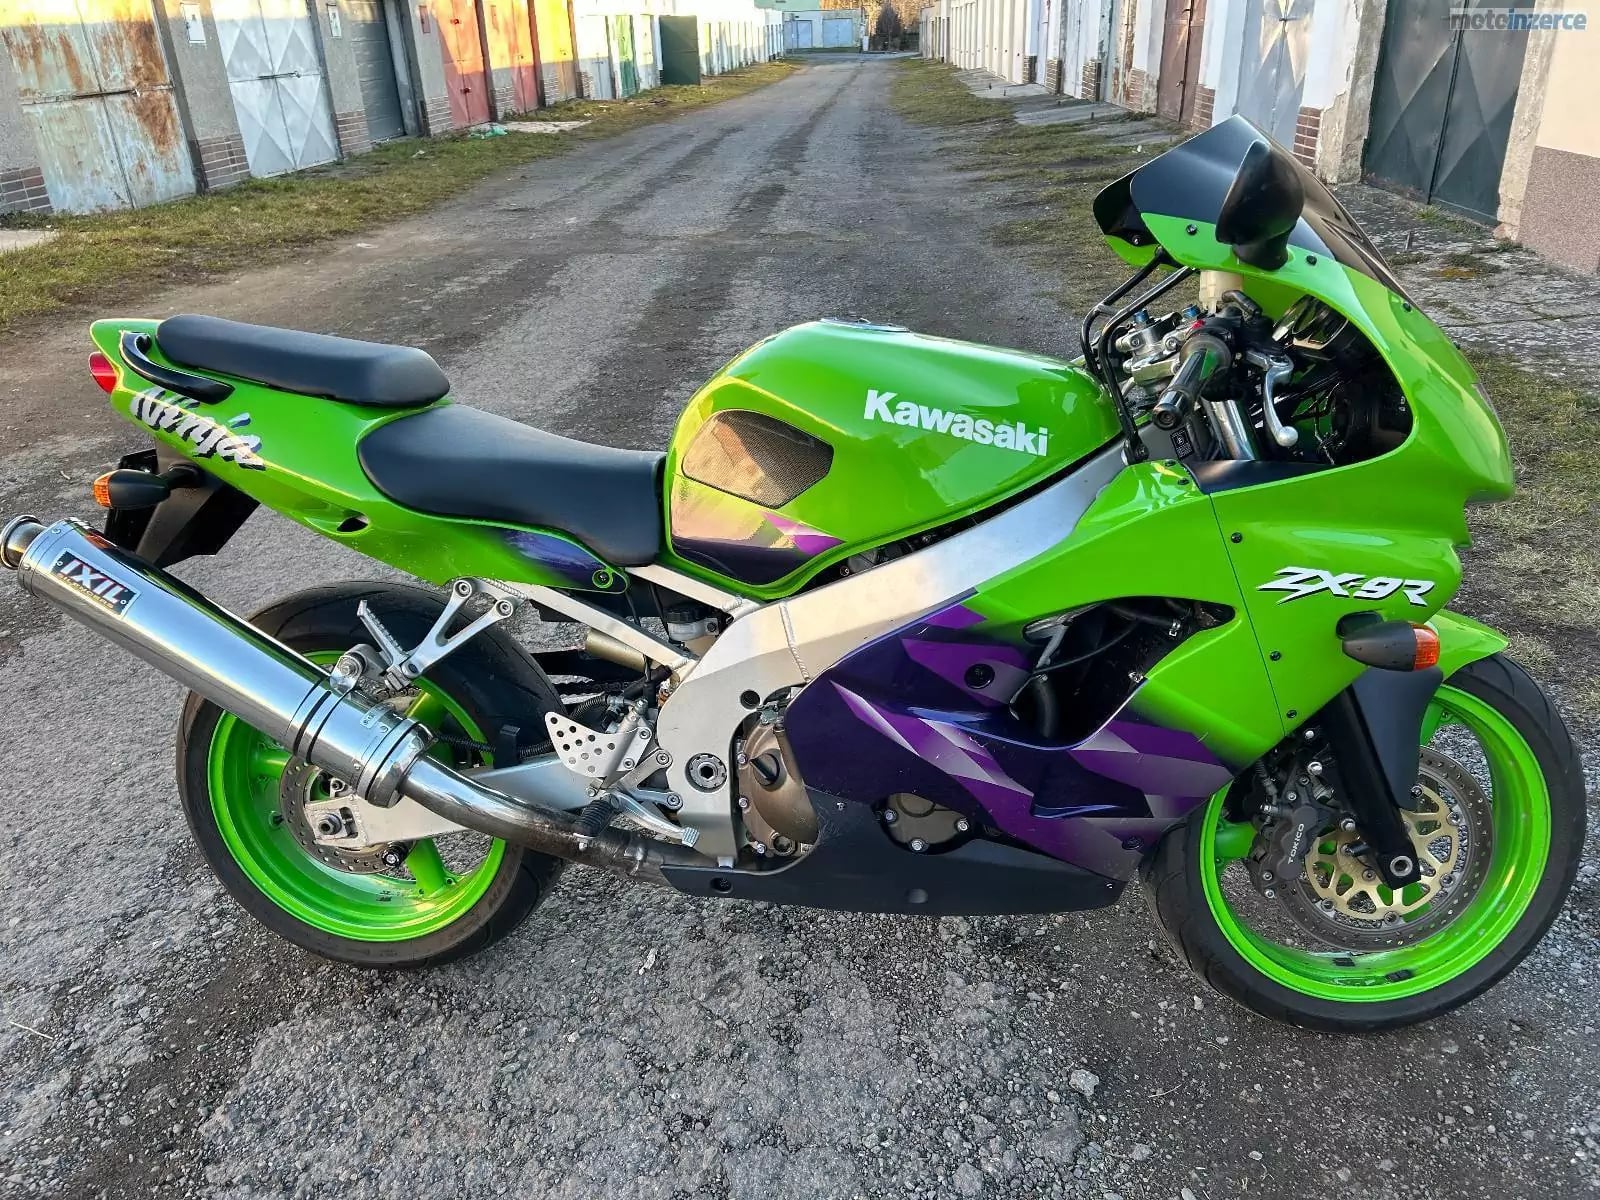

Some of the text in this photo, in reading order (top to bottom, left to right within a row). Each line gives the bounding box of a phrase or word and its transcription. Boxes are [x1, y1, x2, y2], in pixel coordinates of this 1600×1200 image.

[129, 385, 266, 471] Ninja
[863, 389, 1048, 457] Kawasaki
[59, 559, 124, 605] IXIL
[1255, 566, 1436, 607] ZX-9R
[1287, 823, 1305, 865] TOKICO
